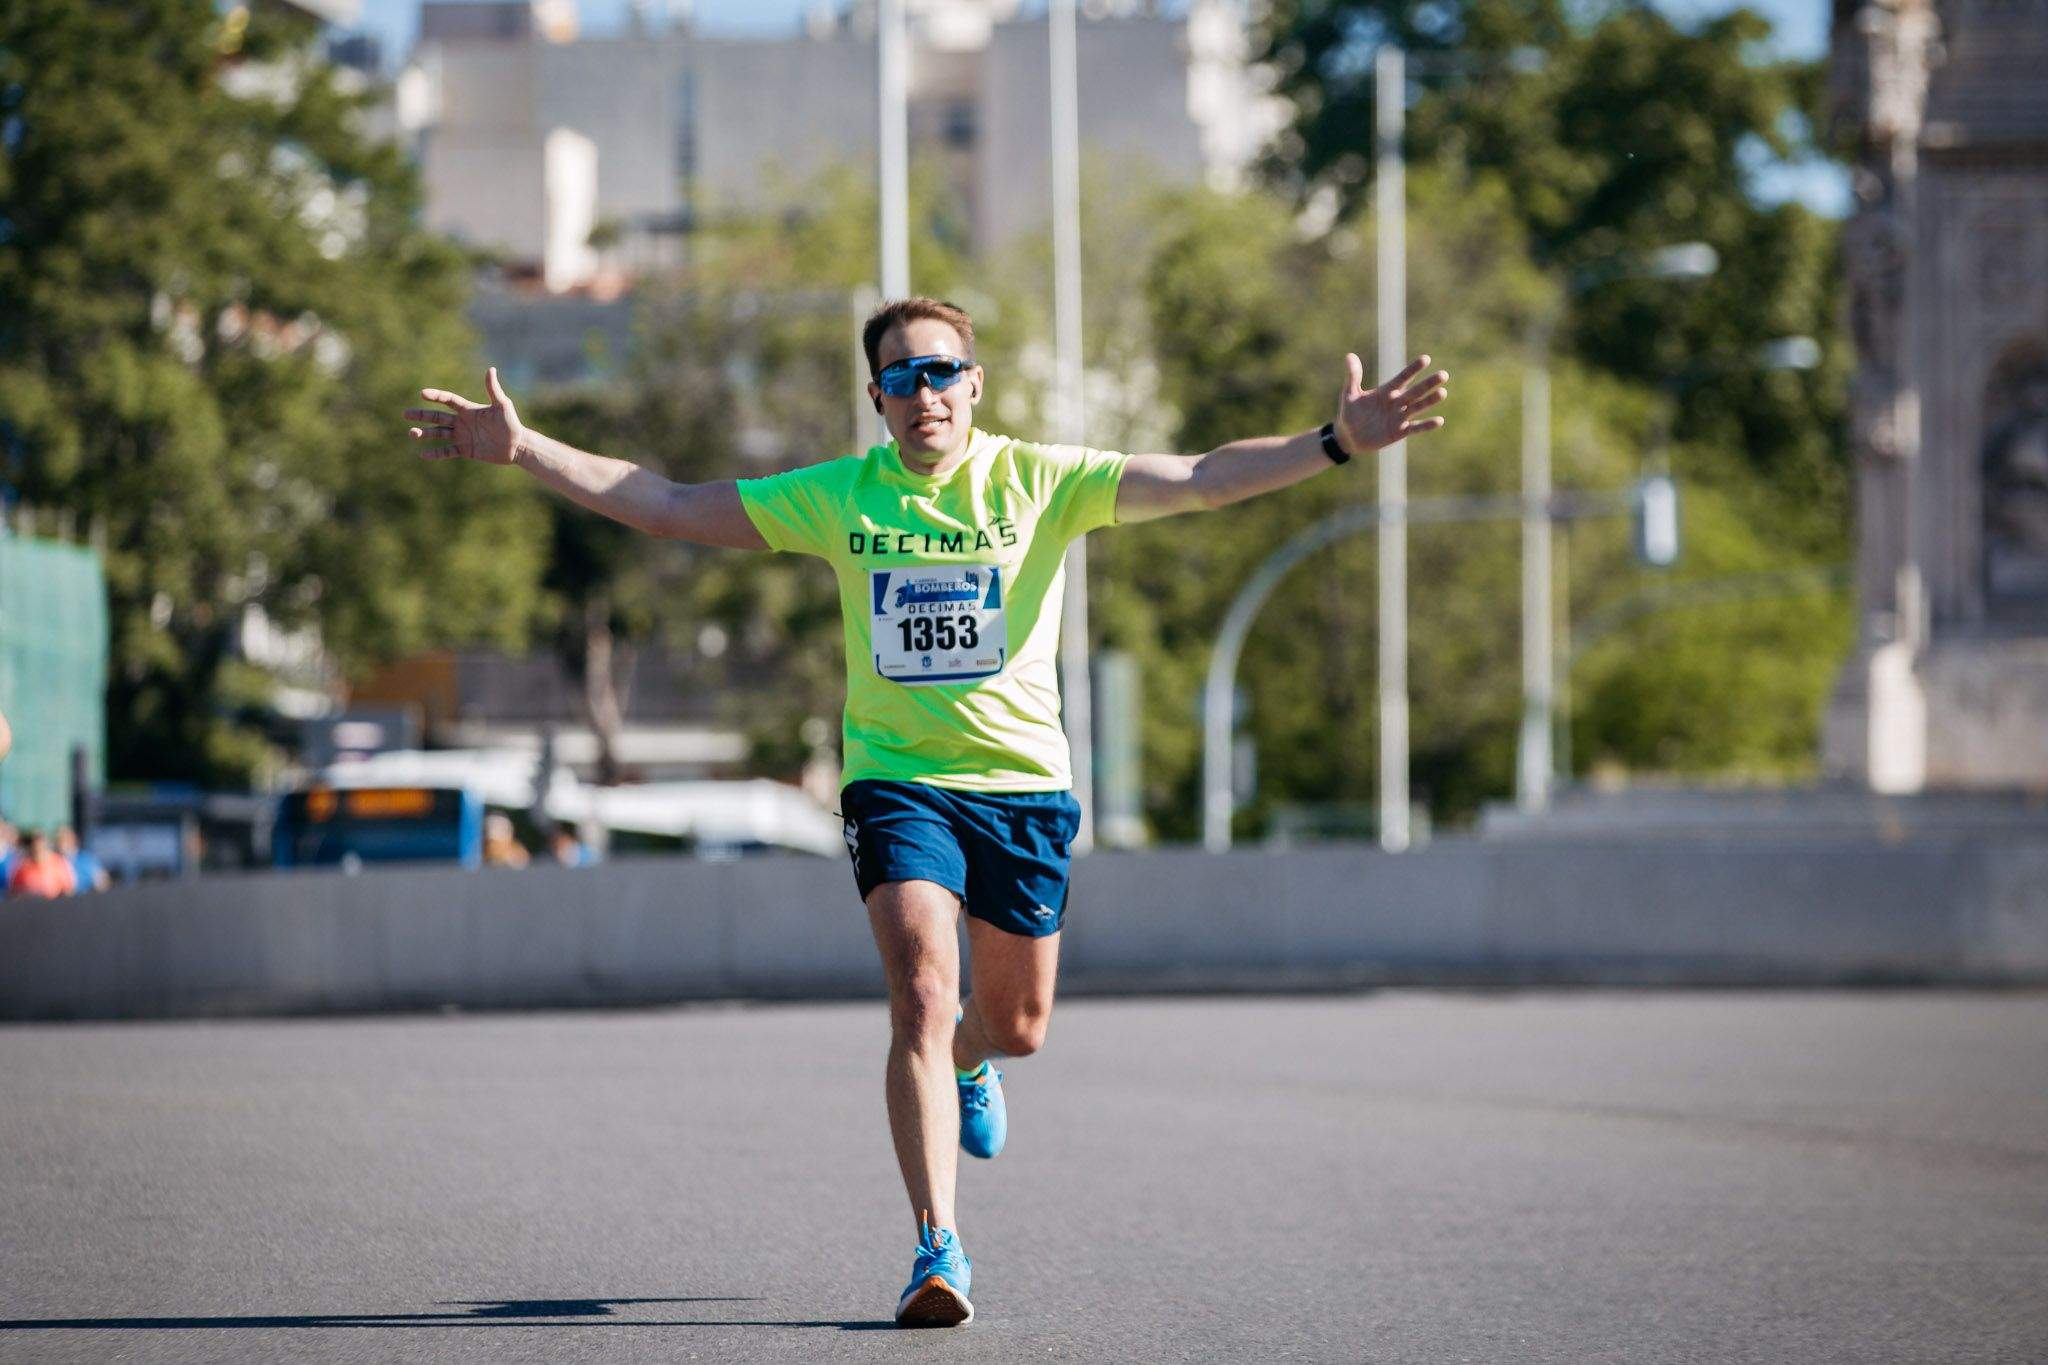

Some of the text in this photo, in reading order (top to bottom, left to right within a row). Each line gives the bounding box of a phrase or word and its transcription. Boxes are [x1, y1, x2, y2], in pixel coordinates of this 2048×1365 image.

[849, 524, 1017, 555] DECIMAS
[914, 581, 977, 593] BOMBEROS
[908, 602, 976, 614] DECIMAS
[897, 615, 979, 652] 1353
